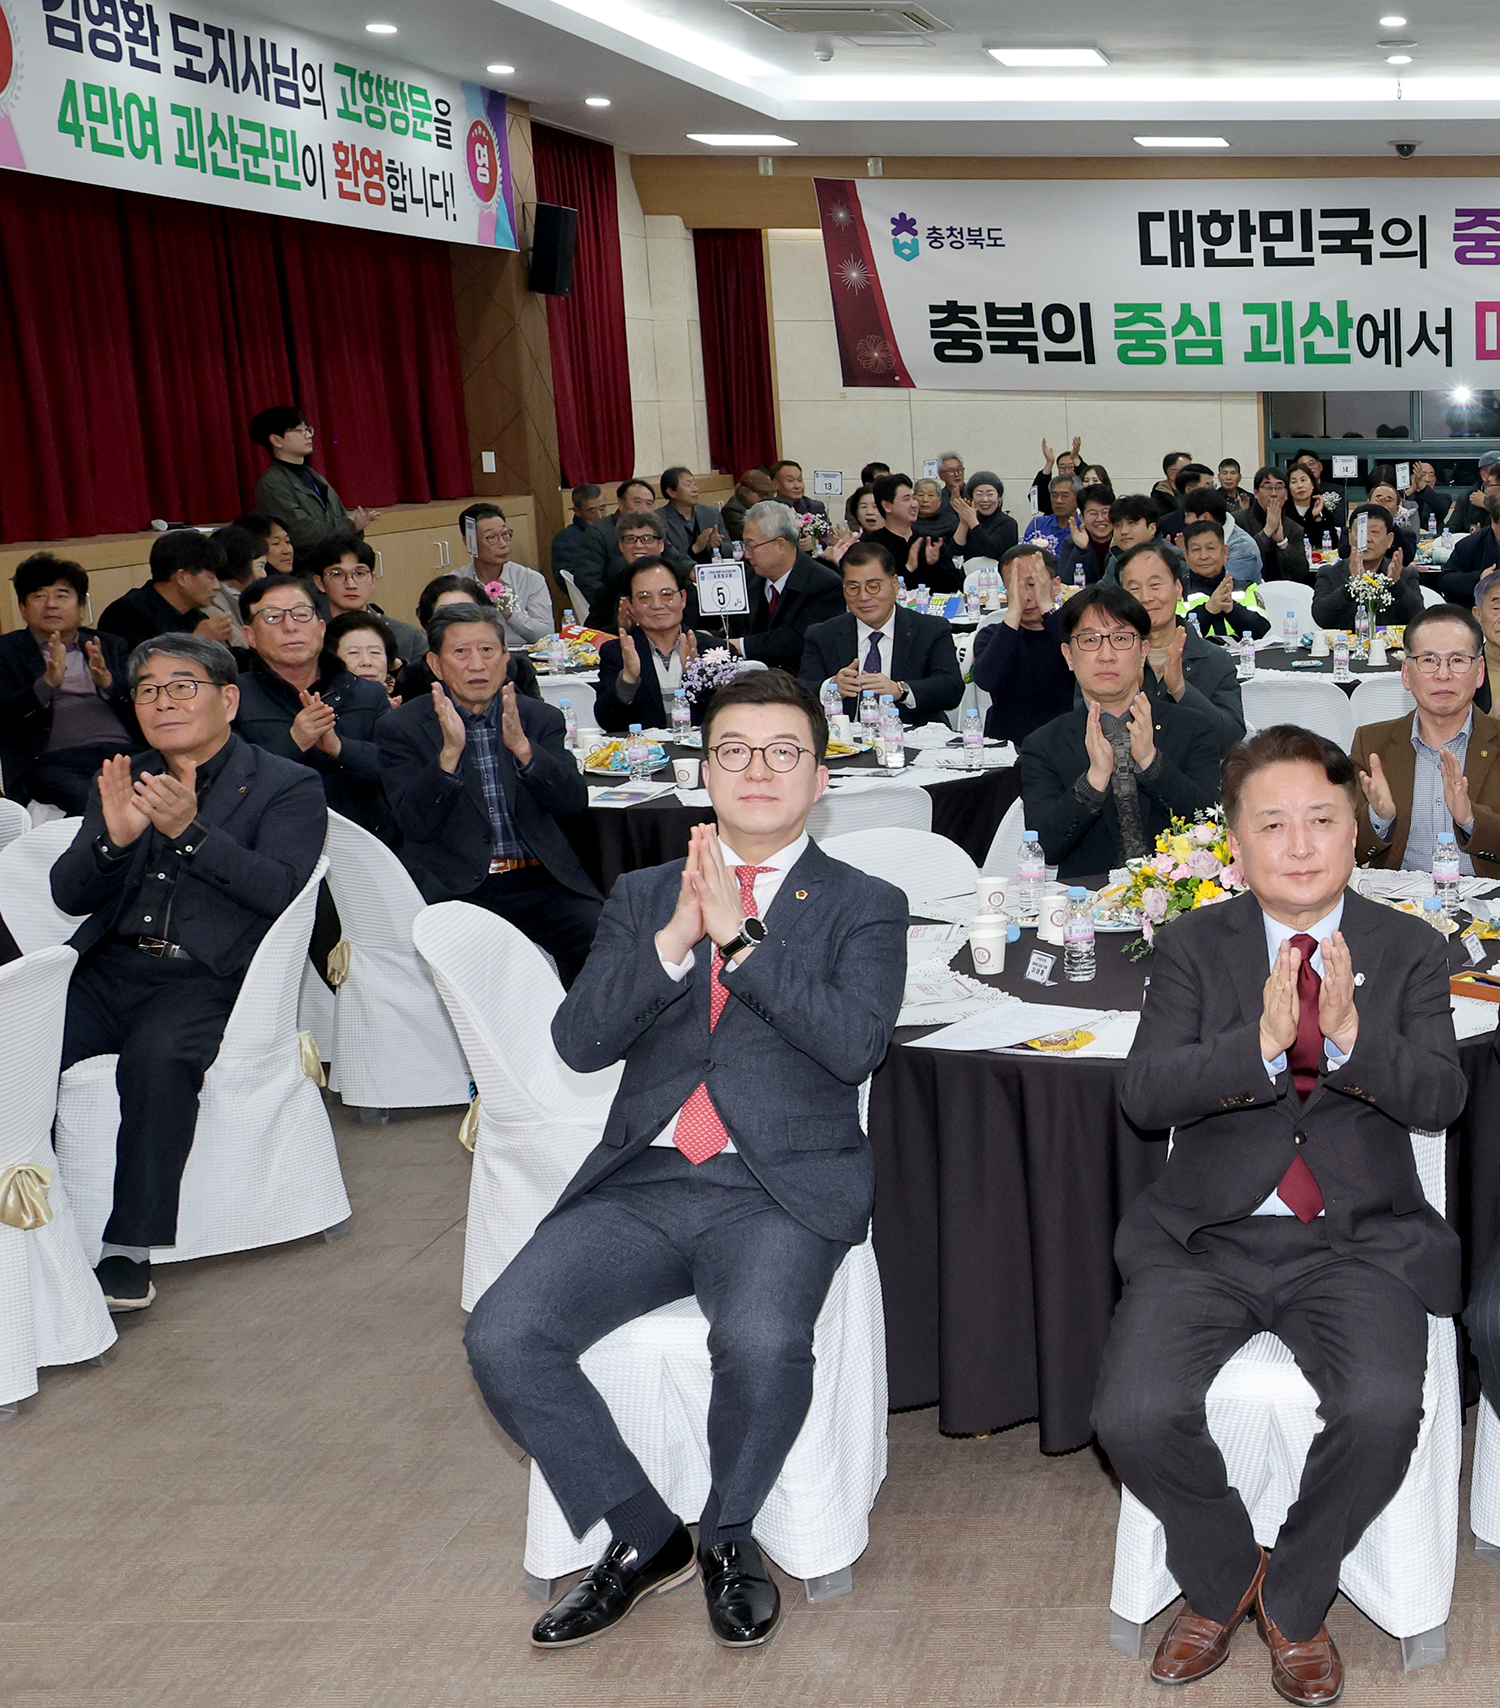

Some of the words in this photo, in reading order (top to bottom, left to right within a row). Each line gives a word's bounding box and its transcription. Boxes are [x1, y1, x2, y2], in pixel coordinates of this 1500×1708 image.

[42, 0, 161, 74] 김영환
[169, 12, 327, 120] 도지사님의
[334, 62, 453, 150] 고향방문을
[57, 78, 162, 165] 4만여
[170, 103, 327, 200] 괴산군민이
[333, 140, 457, 222] 환영합니다!
[474, 143, 491, 184] 영
[926, 225, 1006, 249] 충청북도
[1138, 208, 1428, 269] 대한민국의
[928, 300, 1097, 365] 충북의
[1113, 301, 1224, 366] 중심
[1243, 300, 1453, 368] 괴산에서
[824, 482, 832, 491] 13
[716, 587, 726, 606] 5
